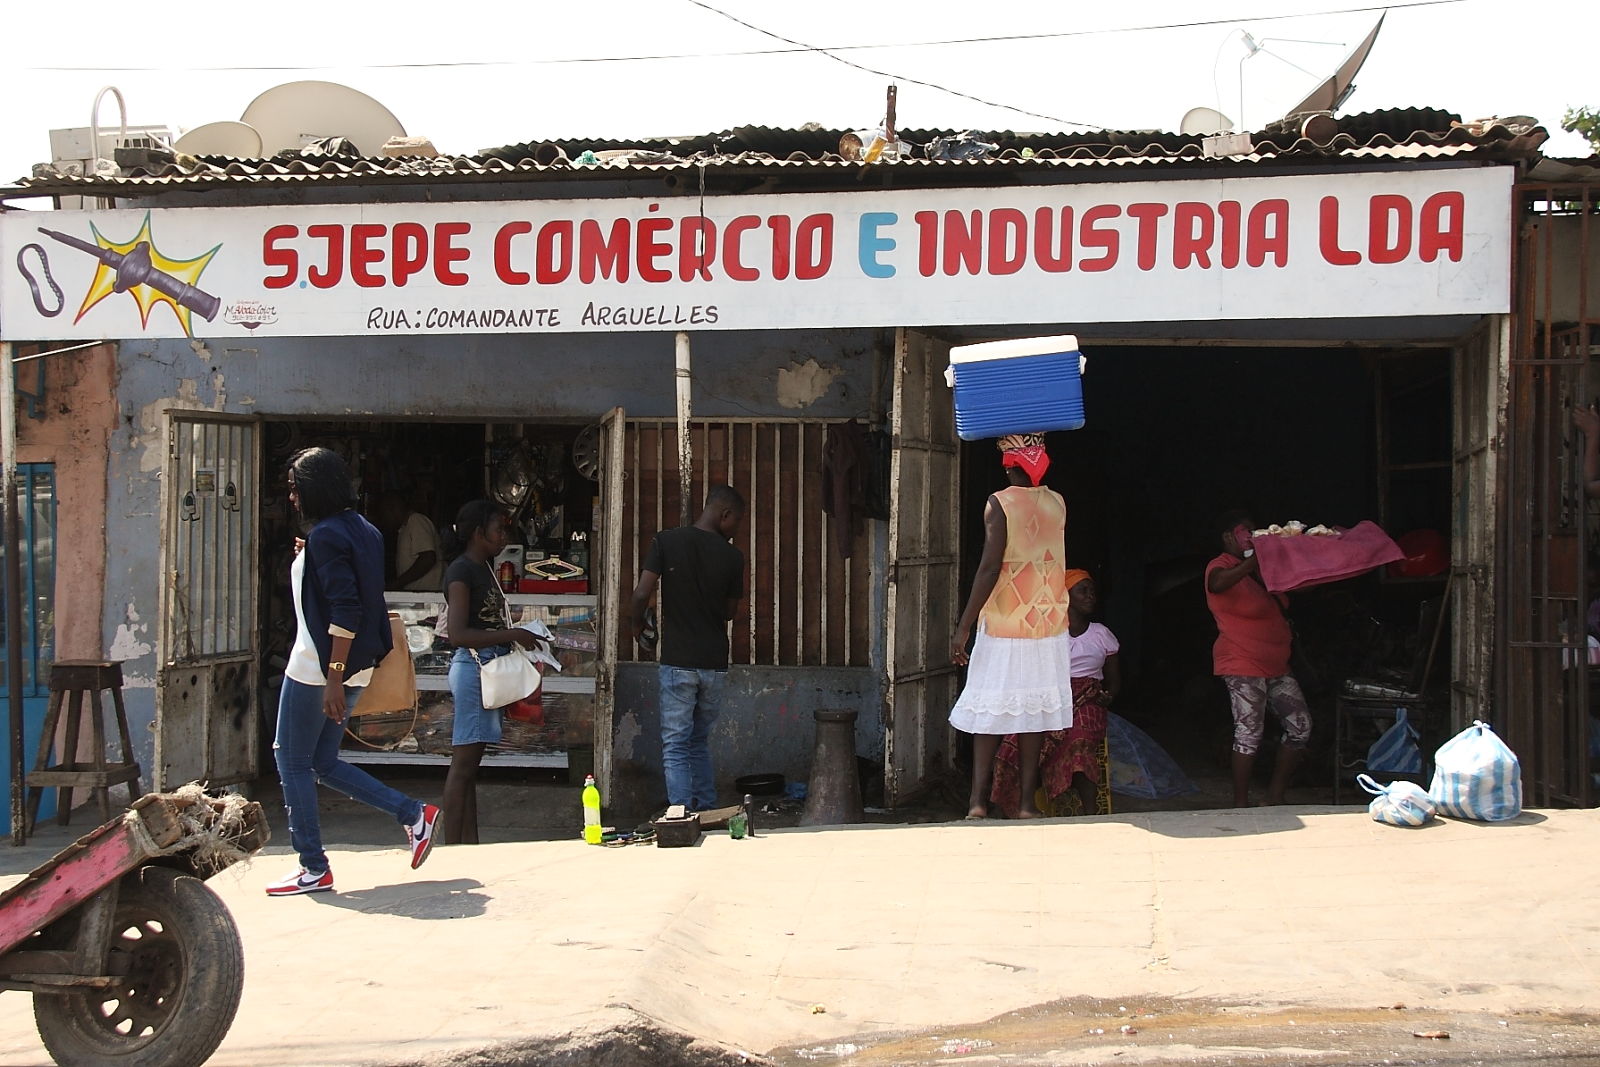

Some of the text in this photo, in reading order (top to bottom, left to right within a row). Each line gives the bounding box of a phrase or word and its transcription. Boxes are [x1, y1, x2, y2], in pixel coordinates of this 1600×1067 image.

[494, 203, 833, 285] COMÉRCIO
[858, 212, 898, 278] E
[914, 199, 1289, 277] INDUSTRIA
[1319, 191, 1464, 266] LDA
[581, 301, 719, 326] ARGUELLES
